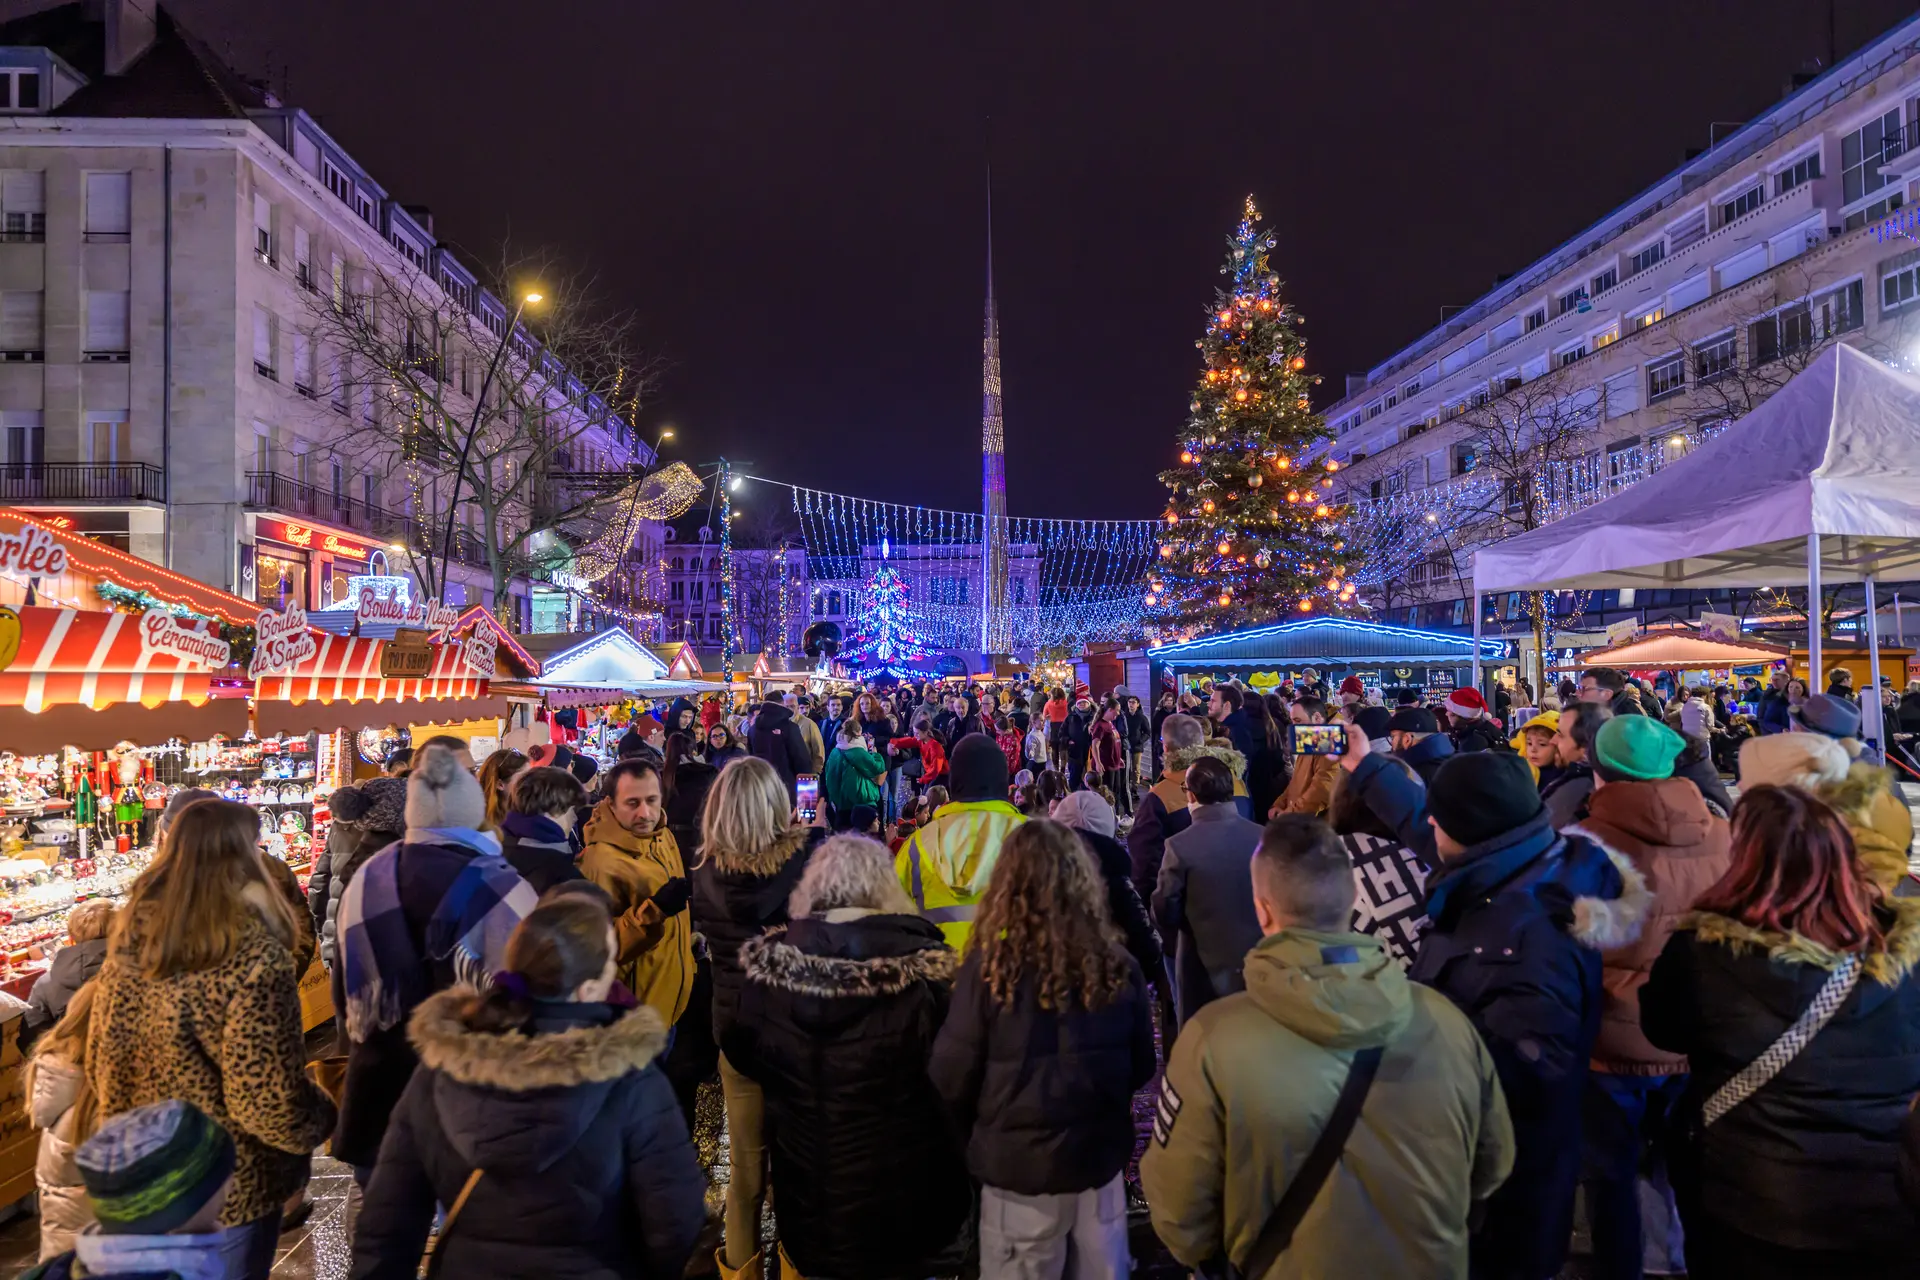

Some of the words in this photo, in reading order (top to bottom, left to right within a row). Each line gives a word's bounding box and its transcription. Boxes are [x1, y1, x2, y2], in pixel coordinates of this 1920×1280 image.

[0, 529, 65, 574] rlée
[259, 604, 304, 640] Boules
[360, 587, 404, 619] Boules
[407, 592, 422, 621] de
[426, 600, 457, 638] Neige
[147, 615, 228, 665] Céramique
[477, 619, 497, 648] Casse
[252, 644, 268, 675] de
[273, 638, 313, 670] Sapin
[406, 653, 428, 669] SHOP
[466, 640, 495, 675] Noisette
